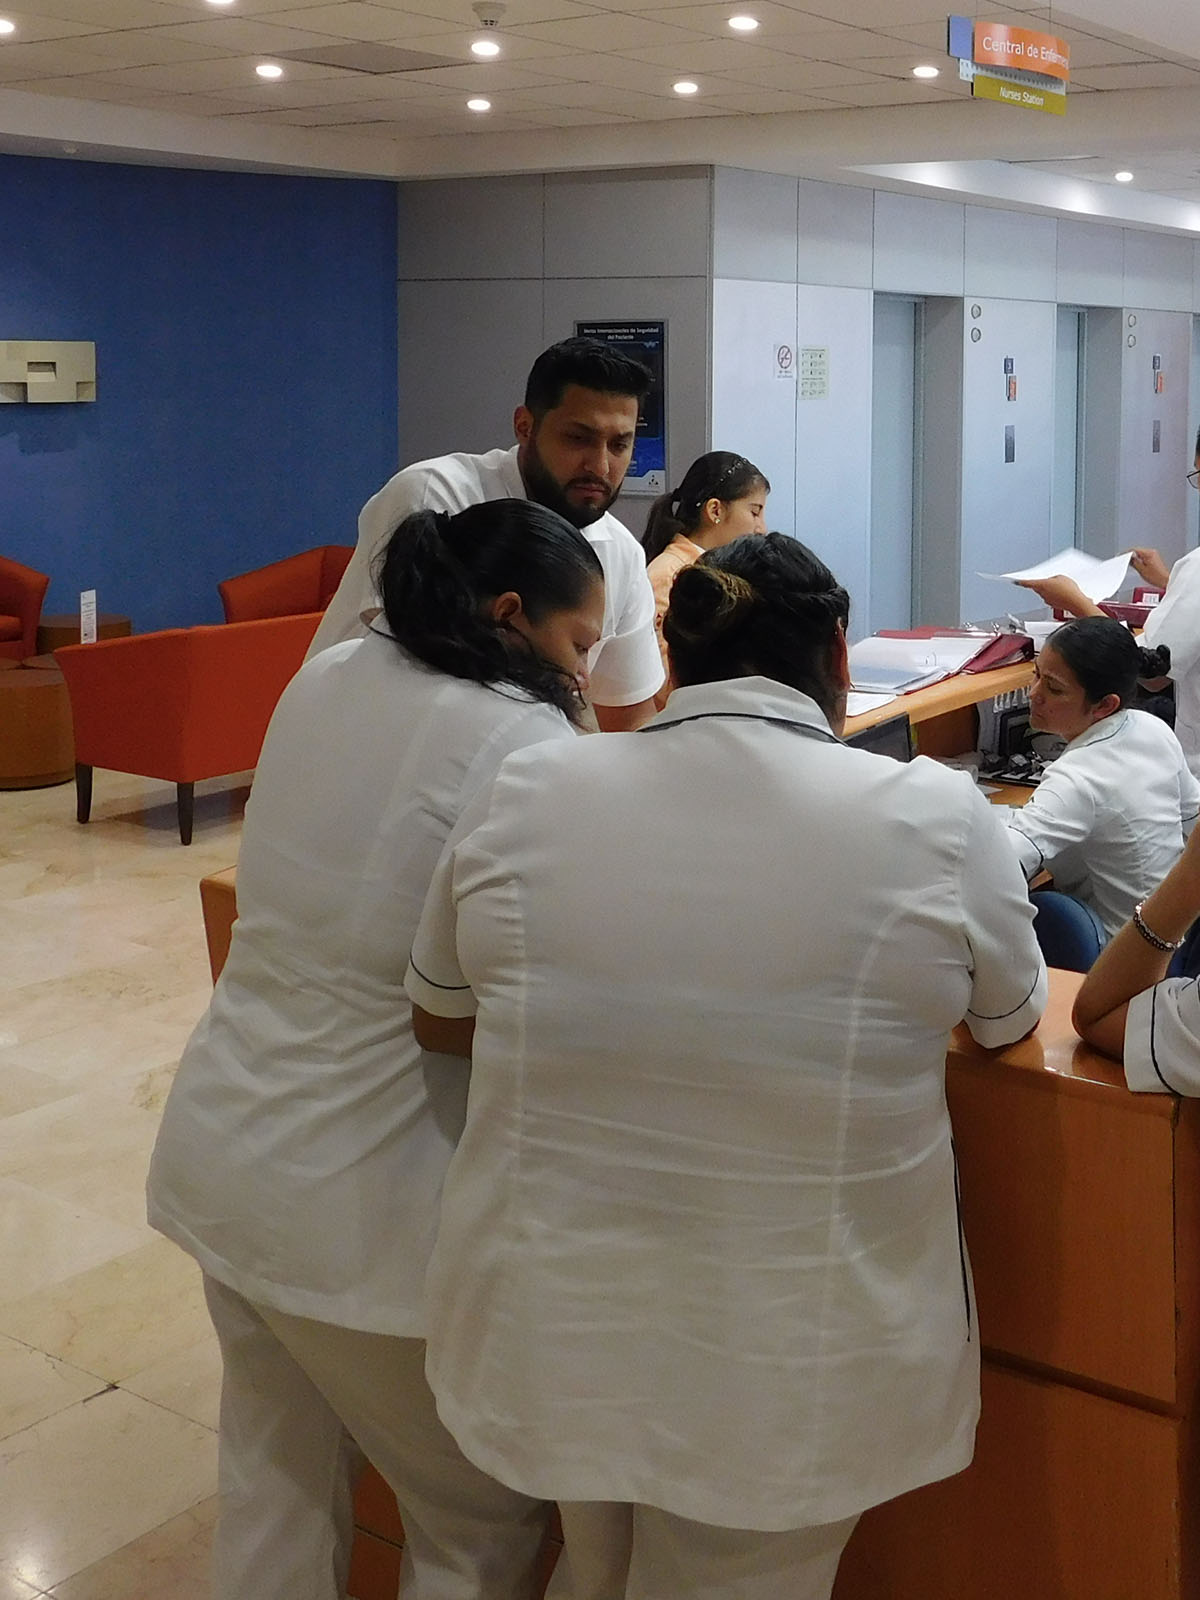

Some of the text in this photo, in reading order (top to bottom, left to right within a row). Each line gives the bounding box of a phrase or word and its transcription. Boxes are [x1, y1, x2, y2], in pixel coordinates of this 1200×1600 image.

[983, 37, 1024, 55] Central
[1027, 44, 1039, 58] de
[1000, 86, 1044, 106] Nurses Station
